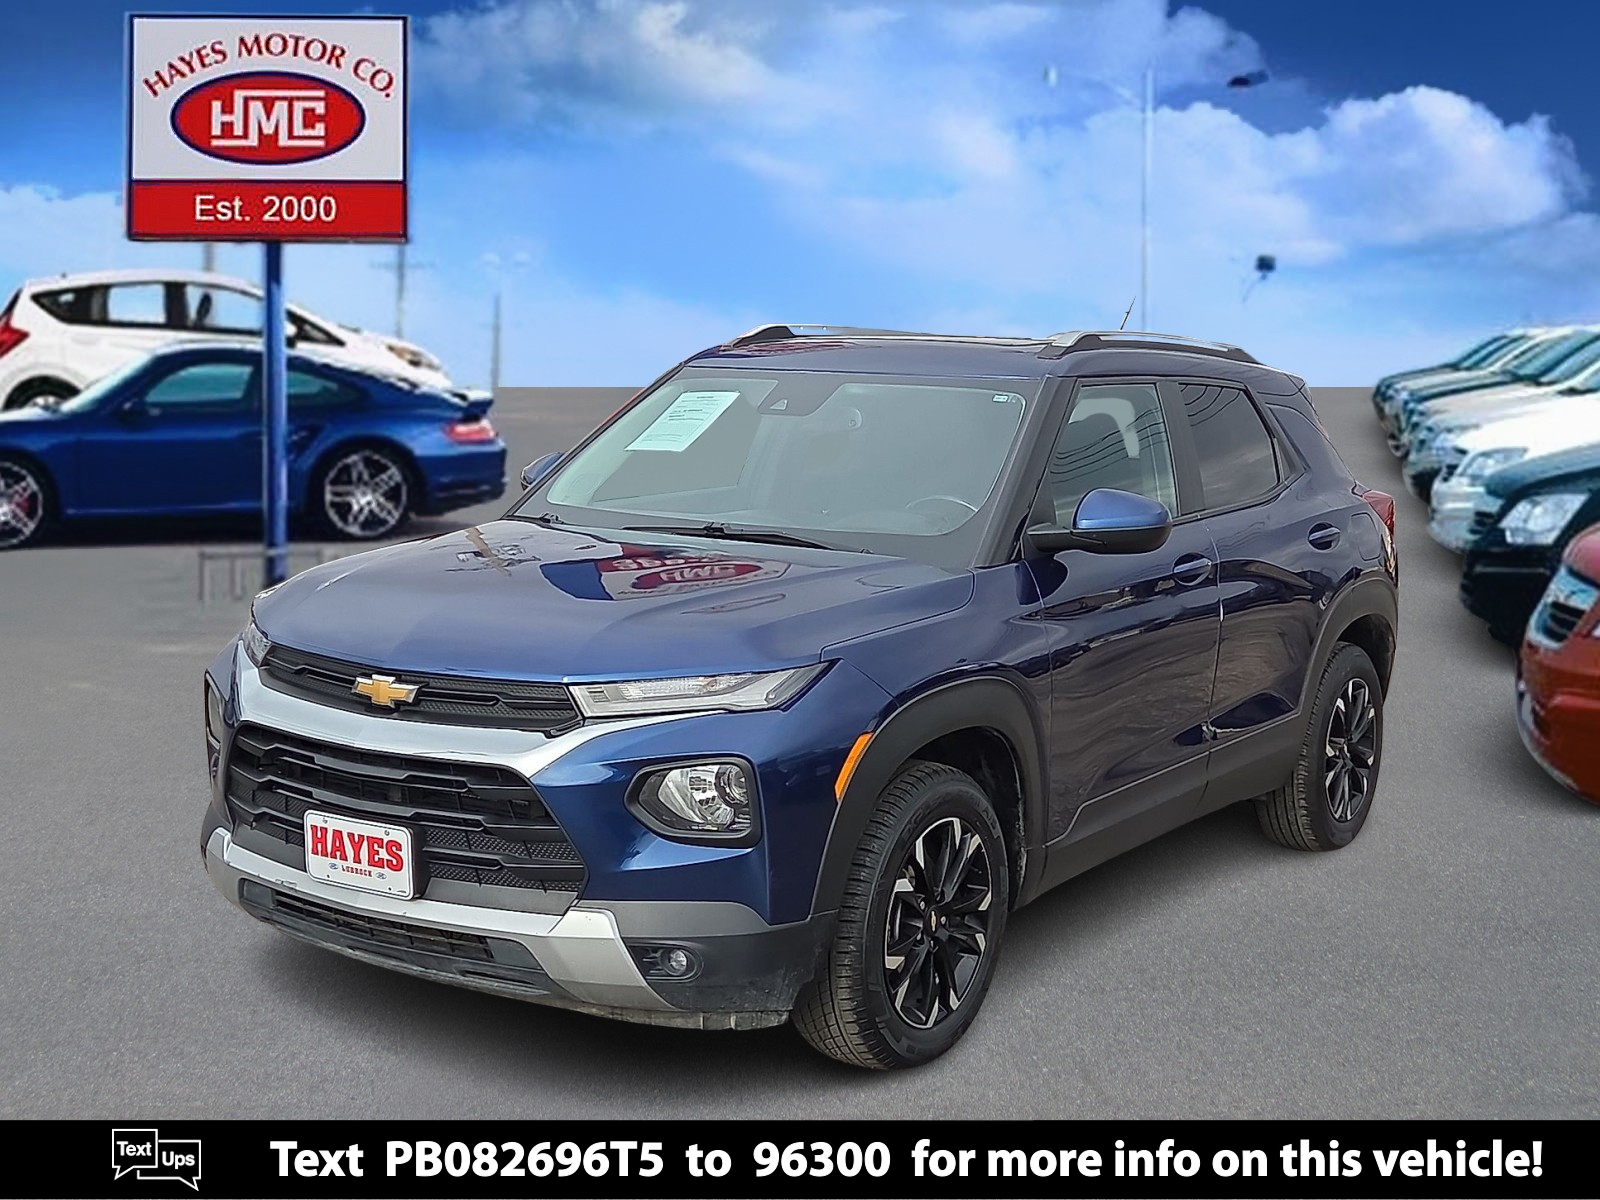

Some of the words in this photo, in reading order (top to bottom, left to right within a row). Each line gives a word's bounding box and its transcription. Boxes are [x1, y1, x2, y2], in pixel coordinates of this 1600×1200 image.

[142, 40, 228, 98] HAYES
[237, 33, 347, 69] MOTOR
[352, 57, 395, 98] CO.
[210, 89, 325, 147] HMC
[194, 194, 250, 221] Est.
[262, 195, 337, 222] 2000
[309, 824, 404, 872] HAYES
